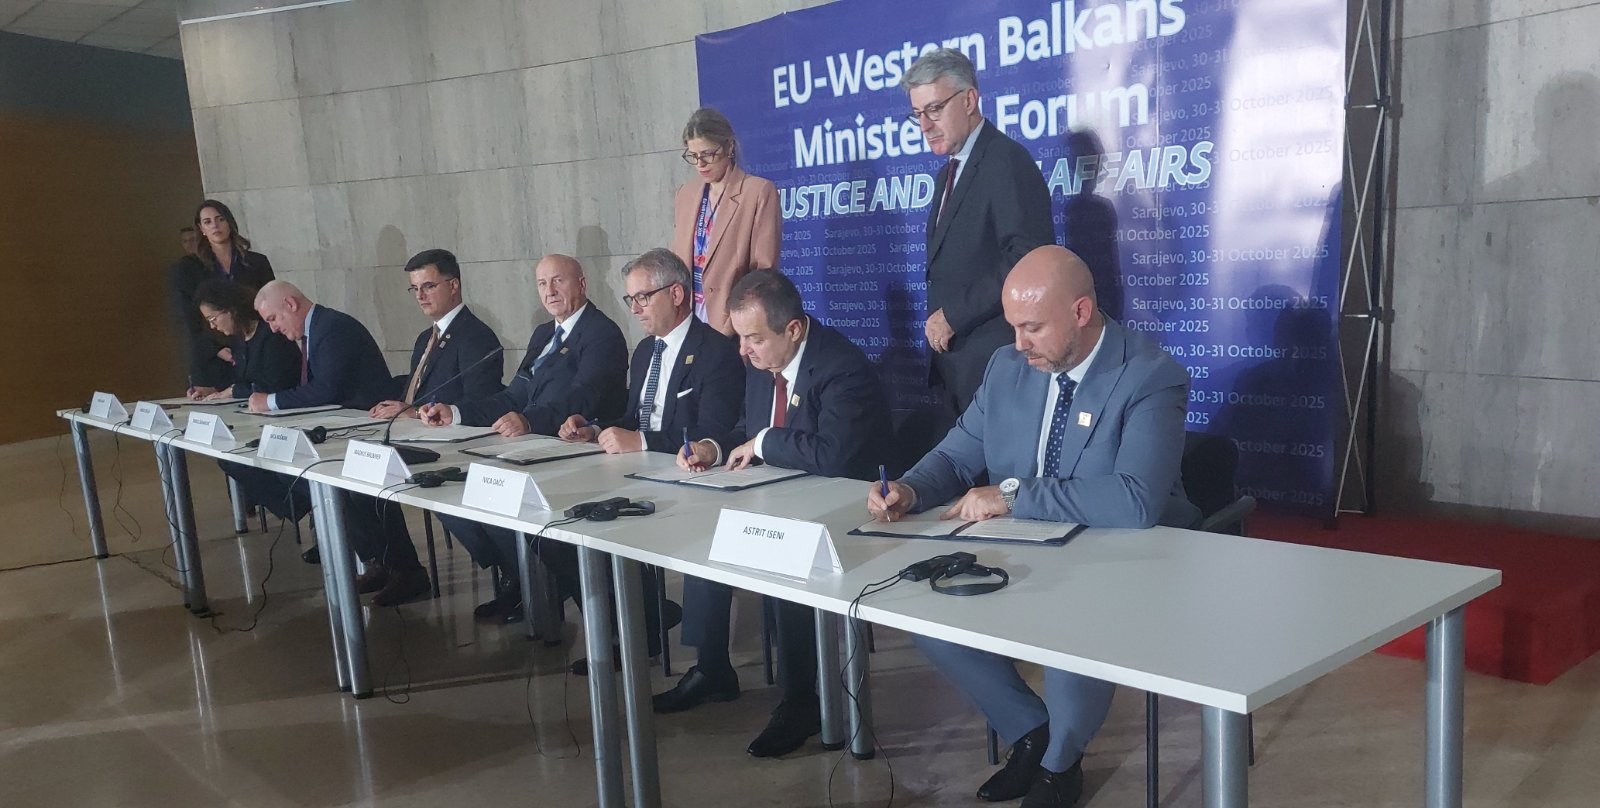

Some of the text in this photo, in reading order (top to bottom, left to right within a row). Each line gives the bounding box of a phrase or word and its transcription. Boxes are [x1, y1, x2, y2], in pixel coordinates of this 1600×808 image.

[1183, 24, 1212, 43] 2025
[773, 0, 1187, 108] EU-Westn Balkans
[1181, 77, 1212, 95] 2025
[795, 83, 1149, 168] Ministe Forum
[1180, 126, 1211, 143] 2025
[1229, 139, 1332, 163] October 2025
[778, 141, 1214, 219] USTICE AND AFFAIRS
[1132, 203, 1188, 220] Sarajevo,
[794, 230, 811, 241] 2025
[824, 228, 860, 240] Sarajevo,
[885, 222, 921, 235] October
[1127, 227, 1177, 242] October
[1179, 225, 1209, 239] 2025
[801, 247, 821, 257] 30-31
[823, 246, 855, 256] October
[857, 244, 877, 254] 2025
[1132, 244, 1329, 267] Sarajevo, 30-31 October 2025
[796, 265, 814, 276] 2025
[827, 261, 922, 277] Sarajevo, 30-31 October
[803, 282, 823, 292] 30-31
[824, 282, 858, 292] October
[859, 280, 879, 291] 2025
[1127, 273, 1177, 288] October
[1179, 272, 1209, 286] 2025
[802, 301, 816, 311] 025
[829, 300, 887, 312] Sarajevo, 30-31
[1132, 295, 1328, 312] Sarajevo, 30-31 October 2025
[826, 317, 860, 328] October
[862, 318, 880, 328] 2025
[1127, 319, 1209, 333] October 2025
[869, 336, 889, 347] 30-31
[1189, 344, 1224, 357] 30-31
[1228, 344, 1289, 359] October
[1292, 345, 1327, 359] 2025
[1186, 366, 1209, 379] 025
[1189, 390, 1326, 409] 30-31 October 2025
[1184, 411, 1209, 424] 025
[1290, 443, 1325, 458] 2025
[742, 526, 785, 540] ASTRIT ISENI
